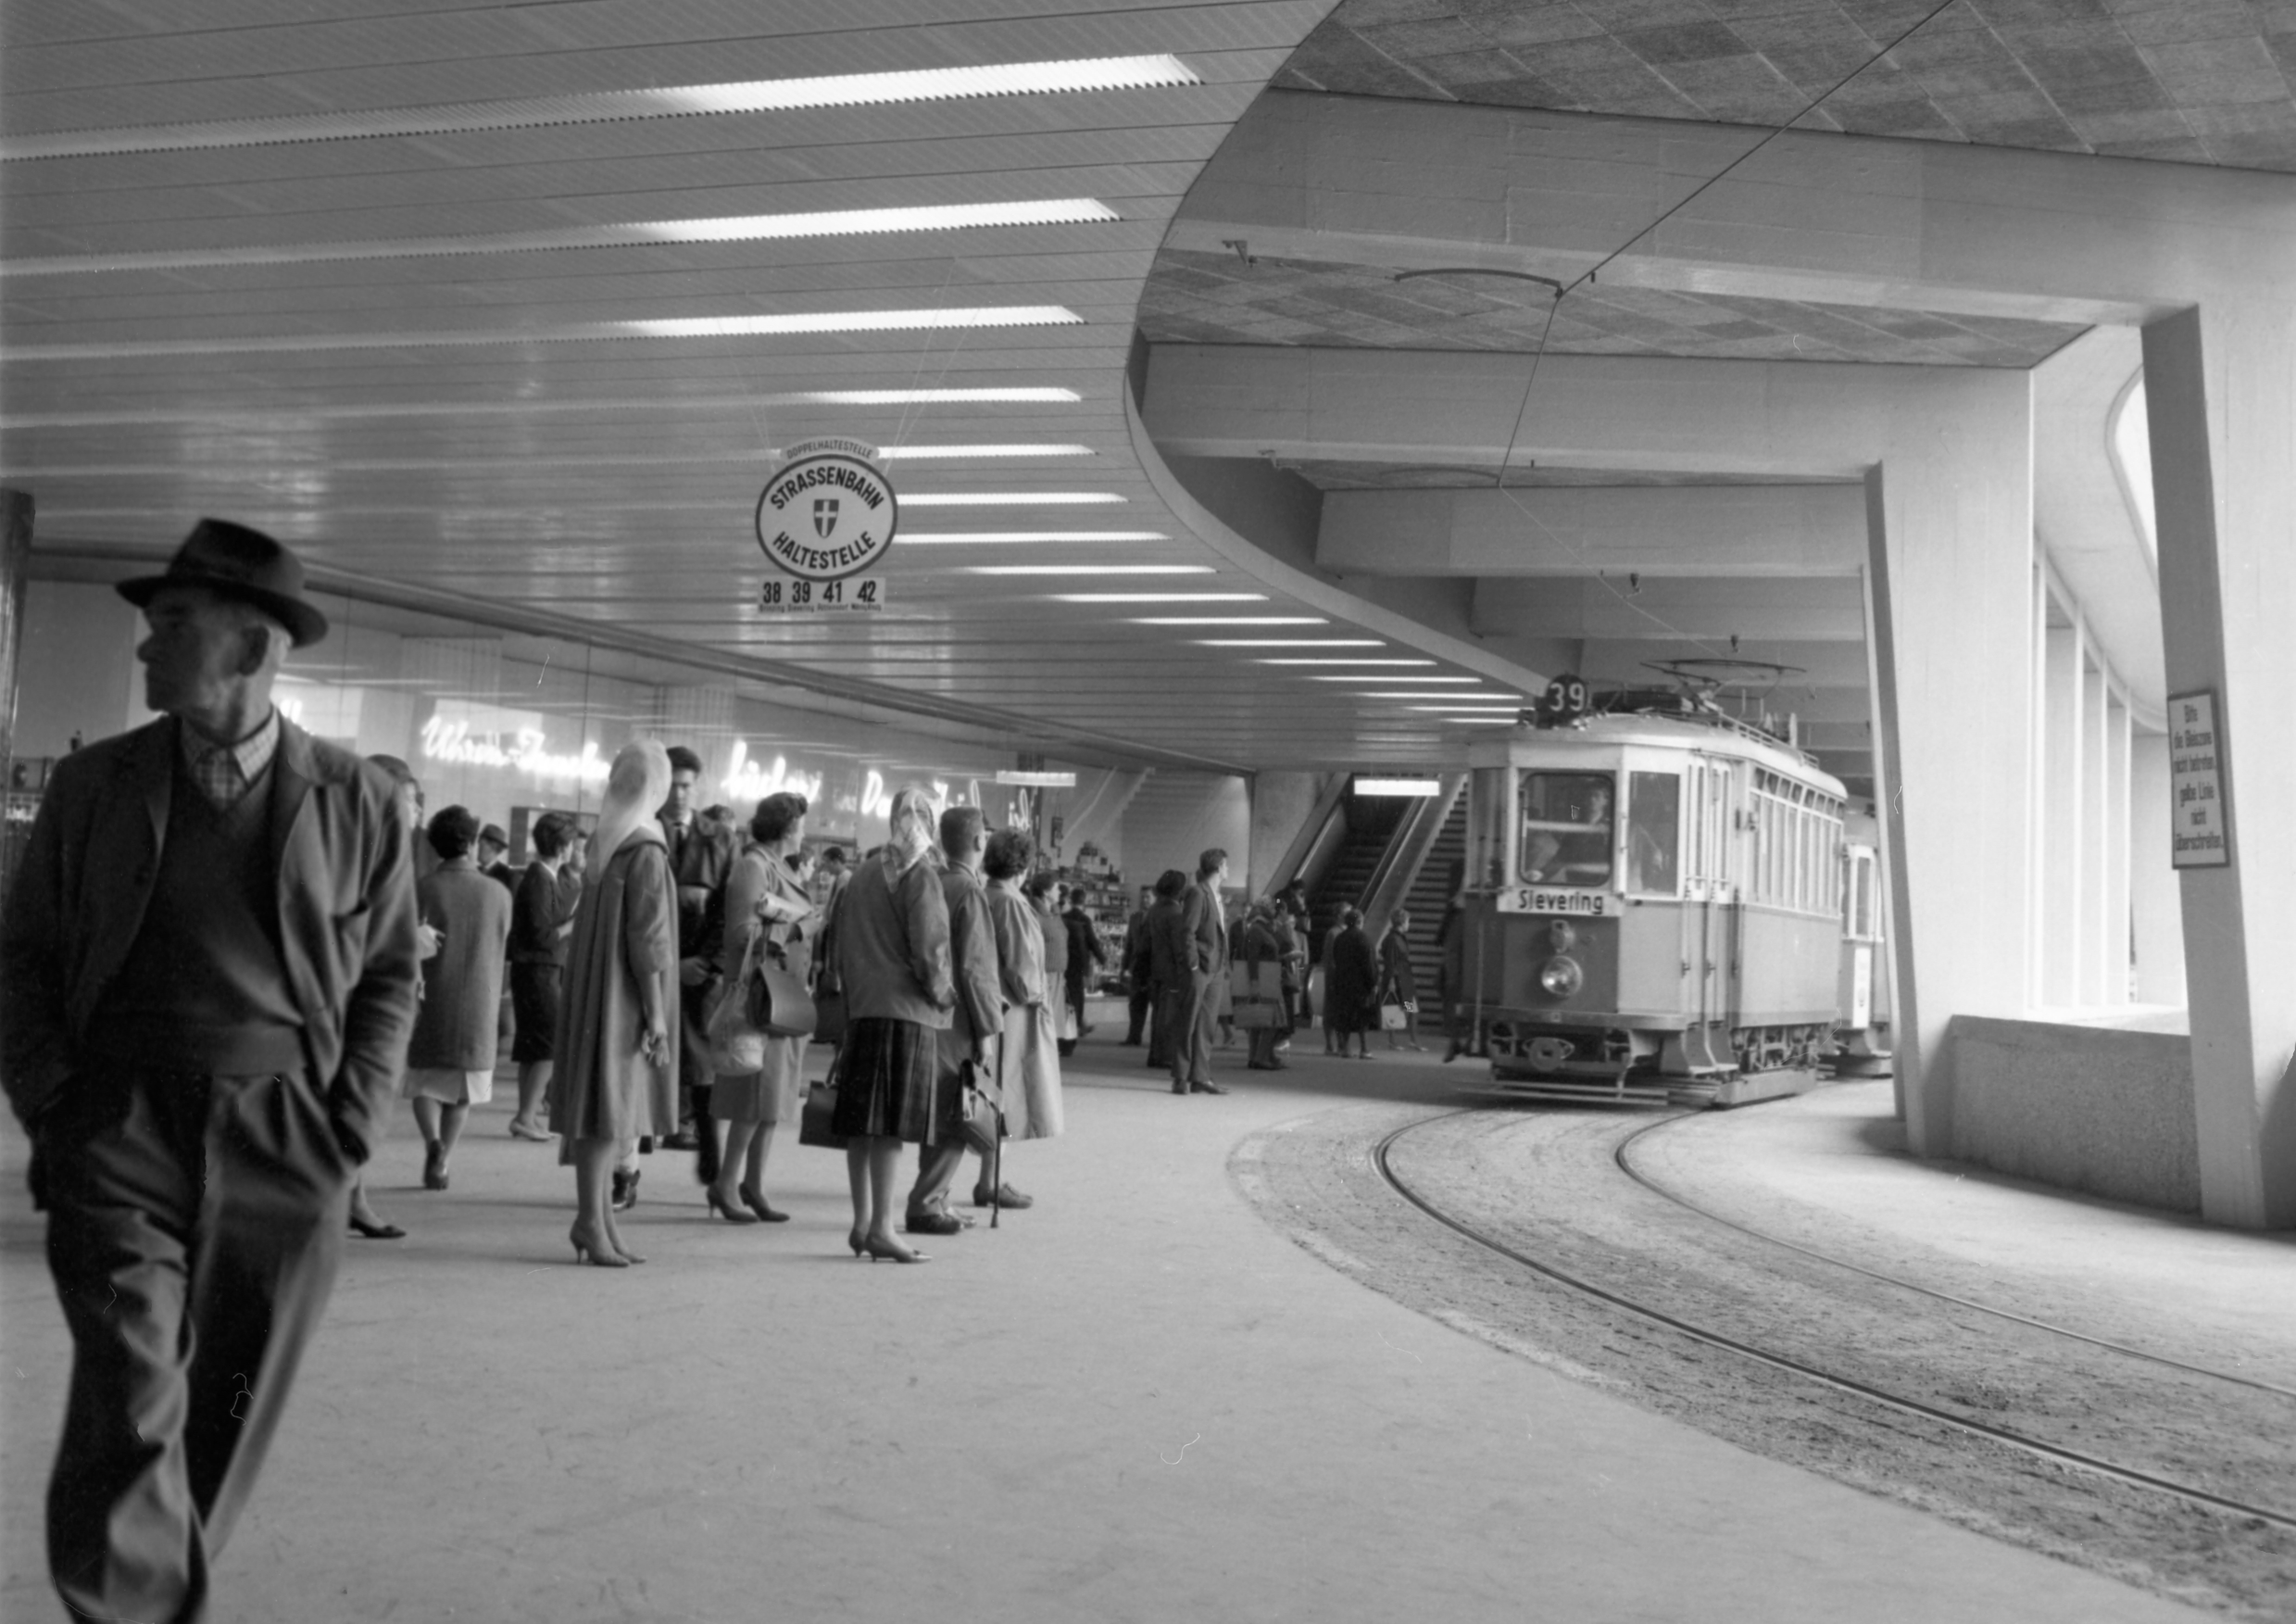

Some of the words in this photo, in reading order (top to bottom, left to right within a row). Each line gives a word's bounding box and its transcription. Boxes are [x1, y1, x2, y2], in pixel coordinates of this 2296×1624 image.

[787, 439, 873, 460] DOPPELHALTESTELLE
[771, 466, 885, 510] STRASSENBAHN
[772, 531, 877, 570] HALTESTELLE
[763, 581, 782, 604] 38
[792, 581, 811, 604] 39
[822, 581, 843, 603] 41
[857, 579, 877, 603] 42
[1549, 682, 1586, 711] 39
[1518, 889, 1603, 914] Sievering
